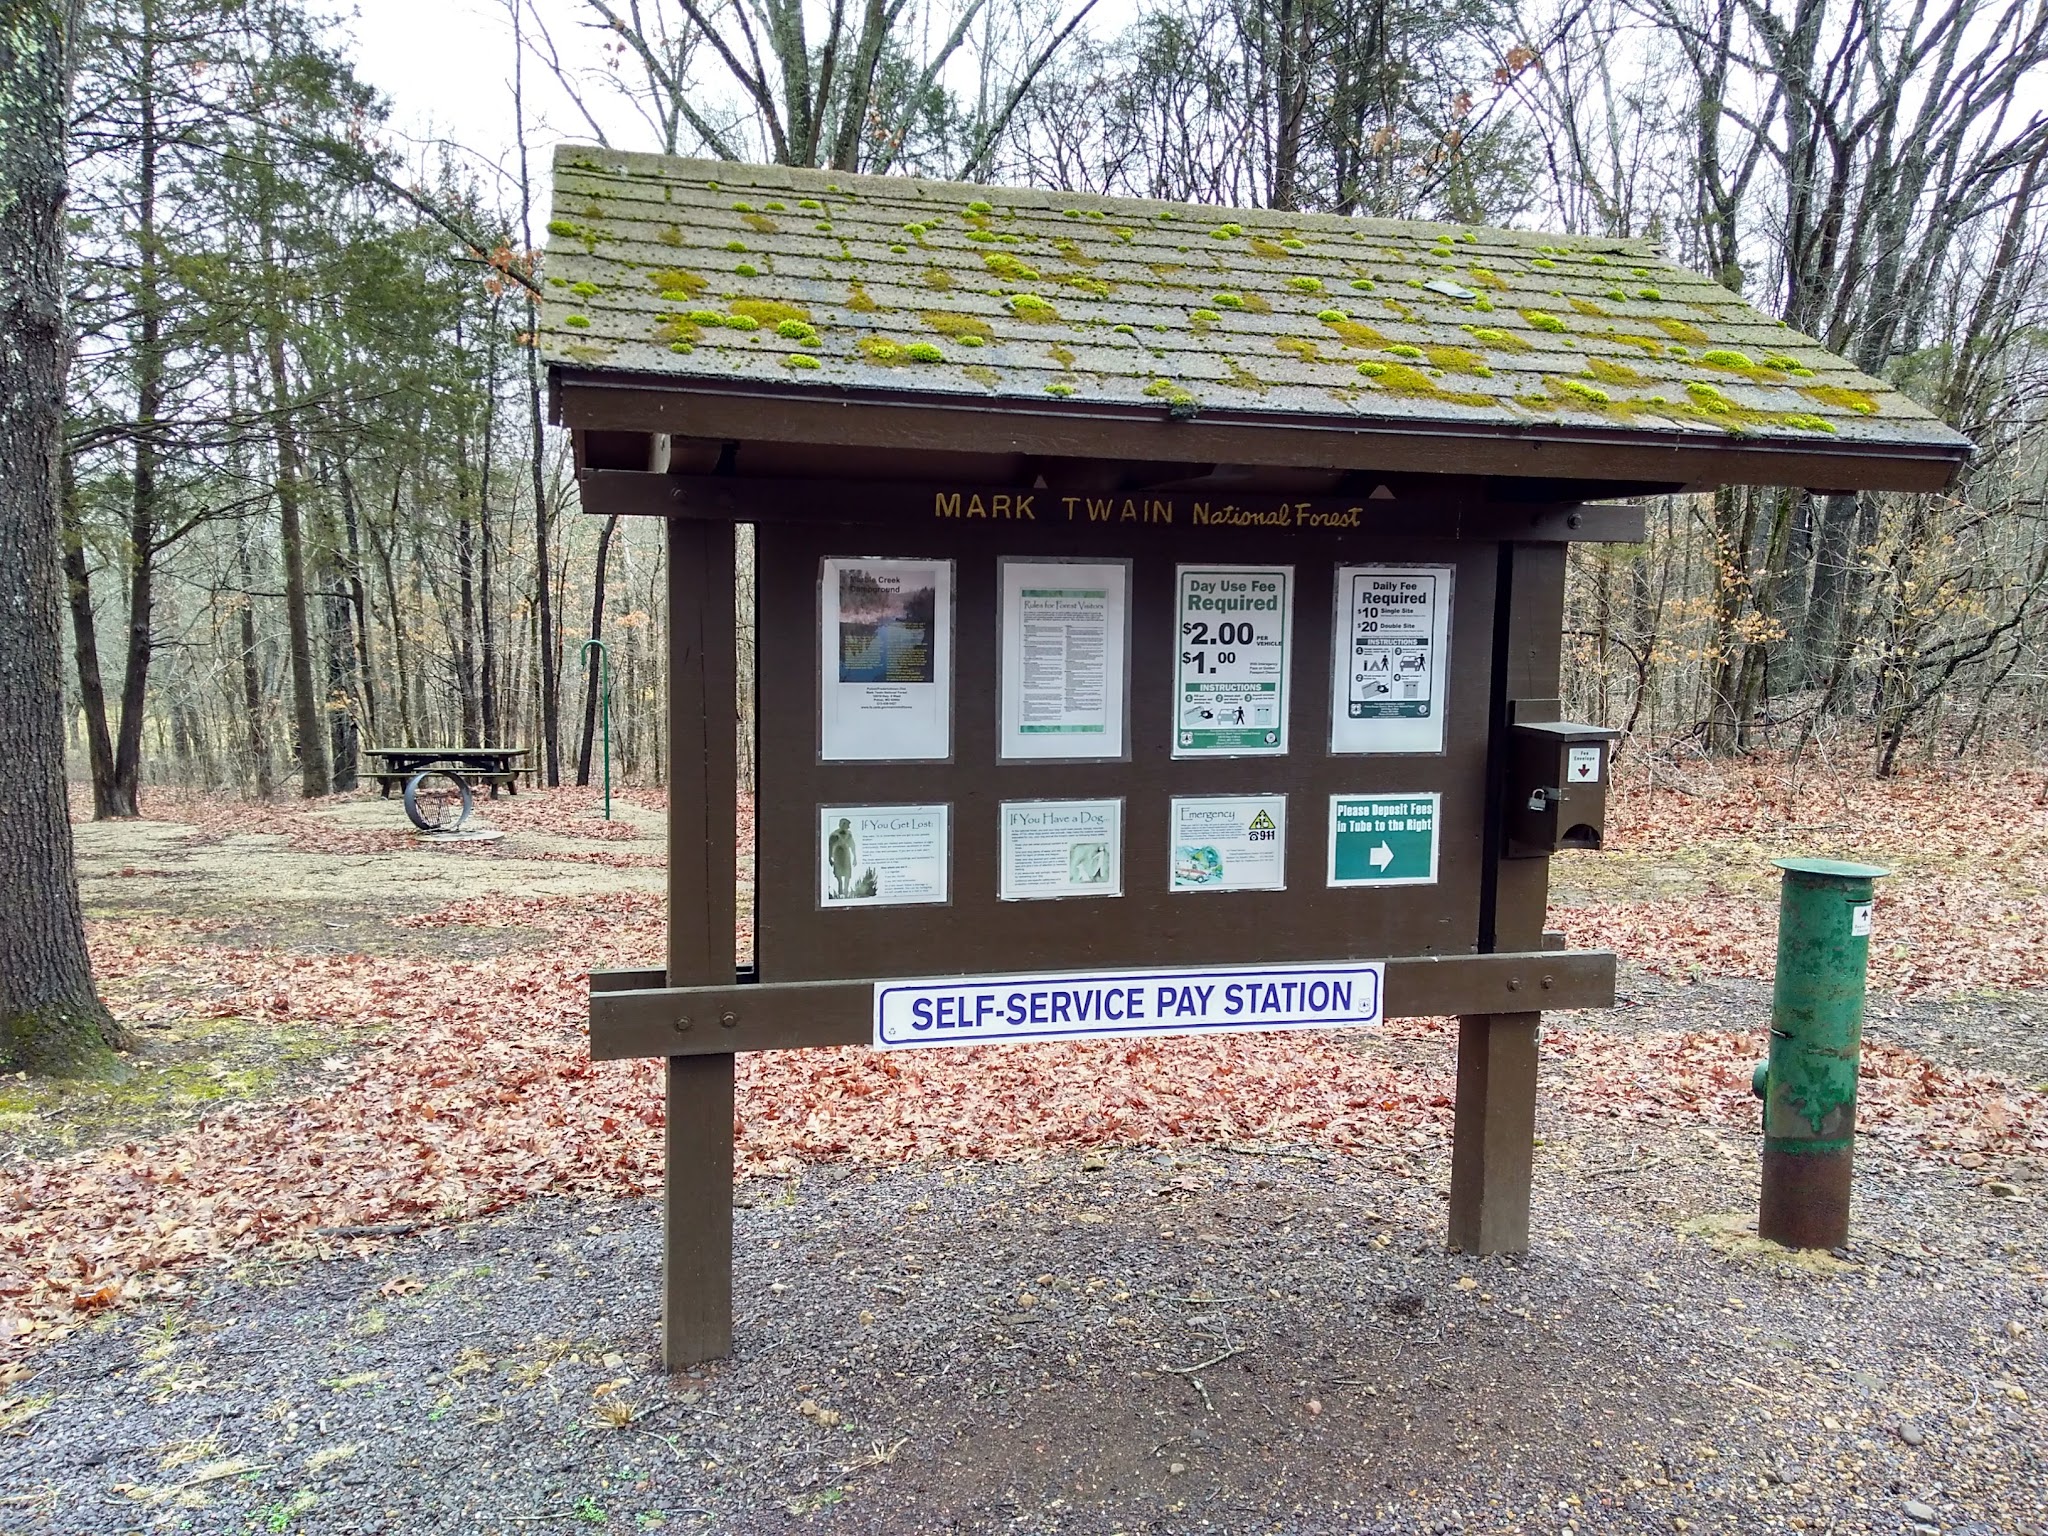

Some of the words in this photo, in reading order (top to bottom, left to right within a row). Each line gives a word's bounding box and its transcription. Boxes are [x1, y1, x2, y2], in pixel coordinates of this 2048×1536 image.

[935, 492, 1035, 520] MARK
[1062, 497, 1173, 524] TWAIN
[1192, 502, 1290, 527] National
[1296, 503, 1363, 528] Forest
[878, 576, 900, 584] Creek
[1190, 580, 1216, 594] Day
[1221, 580, 1247, 592] Use
[1251, 580, 1276, 592] Fee
[1373, 582, 1397, 592] Daily
[1400, 582, 1417, 590] Fee
[1024, 600, 1043, 610] Rules
[1044, 600, 1055, 608] for
[1056, 600, 1077, 610] Forest
[1078, 601, 1104, 610] Visitors
[1188, 594, 1278, 614] Required
[1362, 592, 1427, 606] Required
[1358, 607, 1378, 618] $10
[1358, 621, 1378, 632] $20
[1182, 622, 1254, 645] $2.00
[1200, 684, 1262, 692] INSTRUCTIONS
[1181, 807, 1235, 822] Emergency
[1337, 804, 1370, 816] Please
[1372, 803, 1408, 817] Deposit
[1410, 803, 1433, 815] Fees
[861, 819, 868, 830] If
[870, 819, 889, 830] You
[890, 818, 909, 830] Get
[1010, 813, 1018, 825] If
[1020, 813, 1040, 825] You
[1043, 812, 1069, 824] Have
[1337, 820, 1347, 832] in
[1349, 819, 1372, 832] Tube
[1375, 819, 1386, 832] to
[1388, 819, 1404, 831] the
[1406, 818, 1432, 832] Right
[1260, 830, 1275, 840] 911
[911, 987, 1144, 1031] SELF-SERVICE
[1156, 985, 1214, 1018] PAY
[1223, 980, 1353, 1015] STATION
